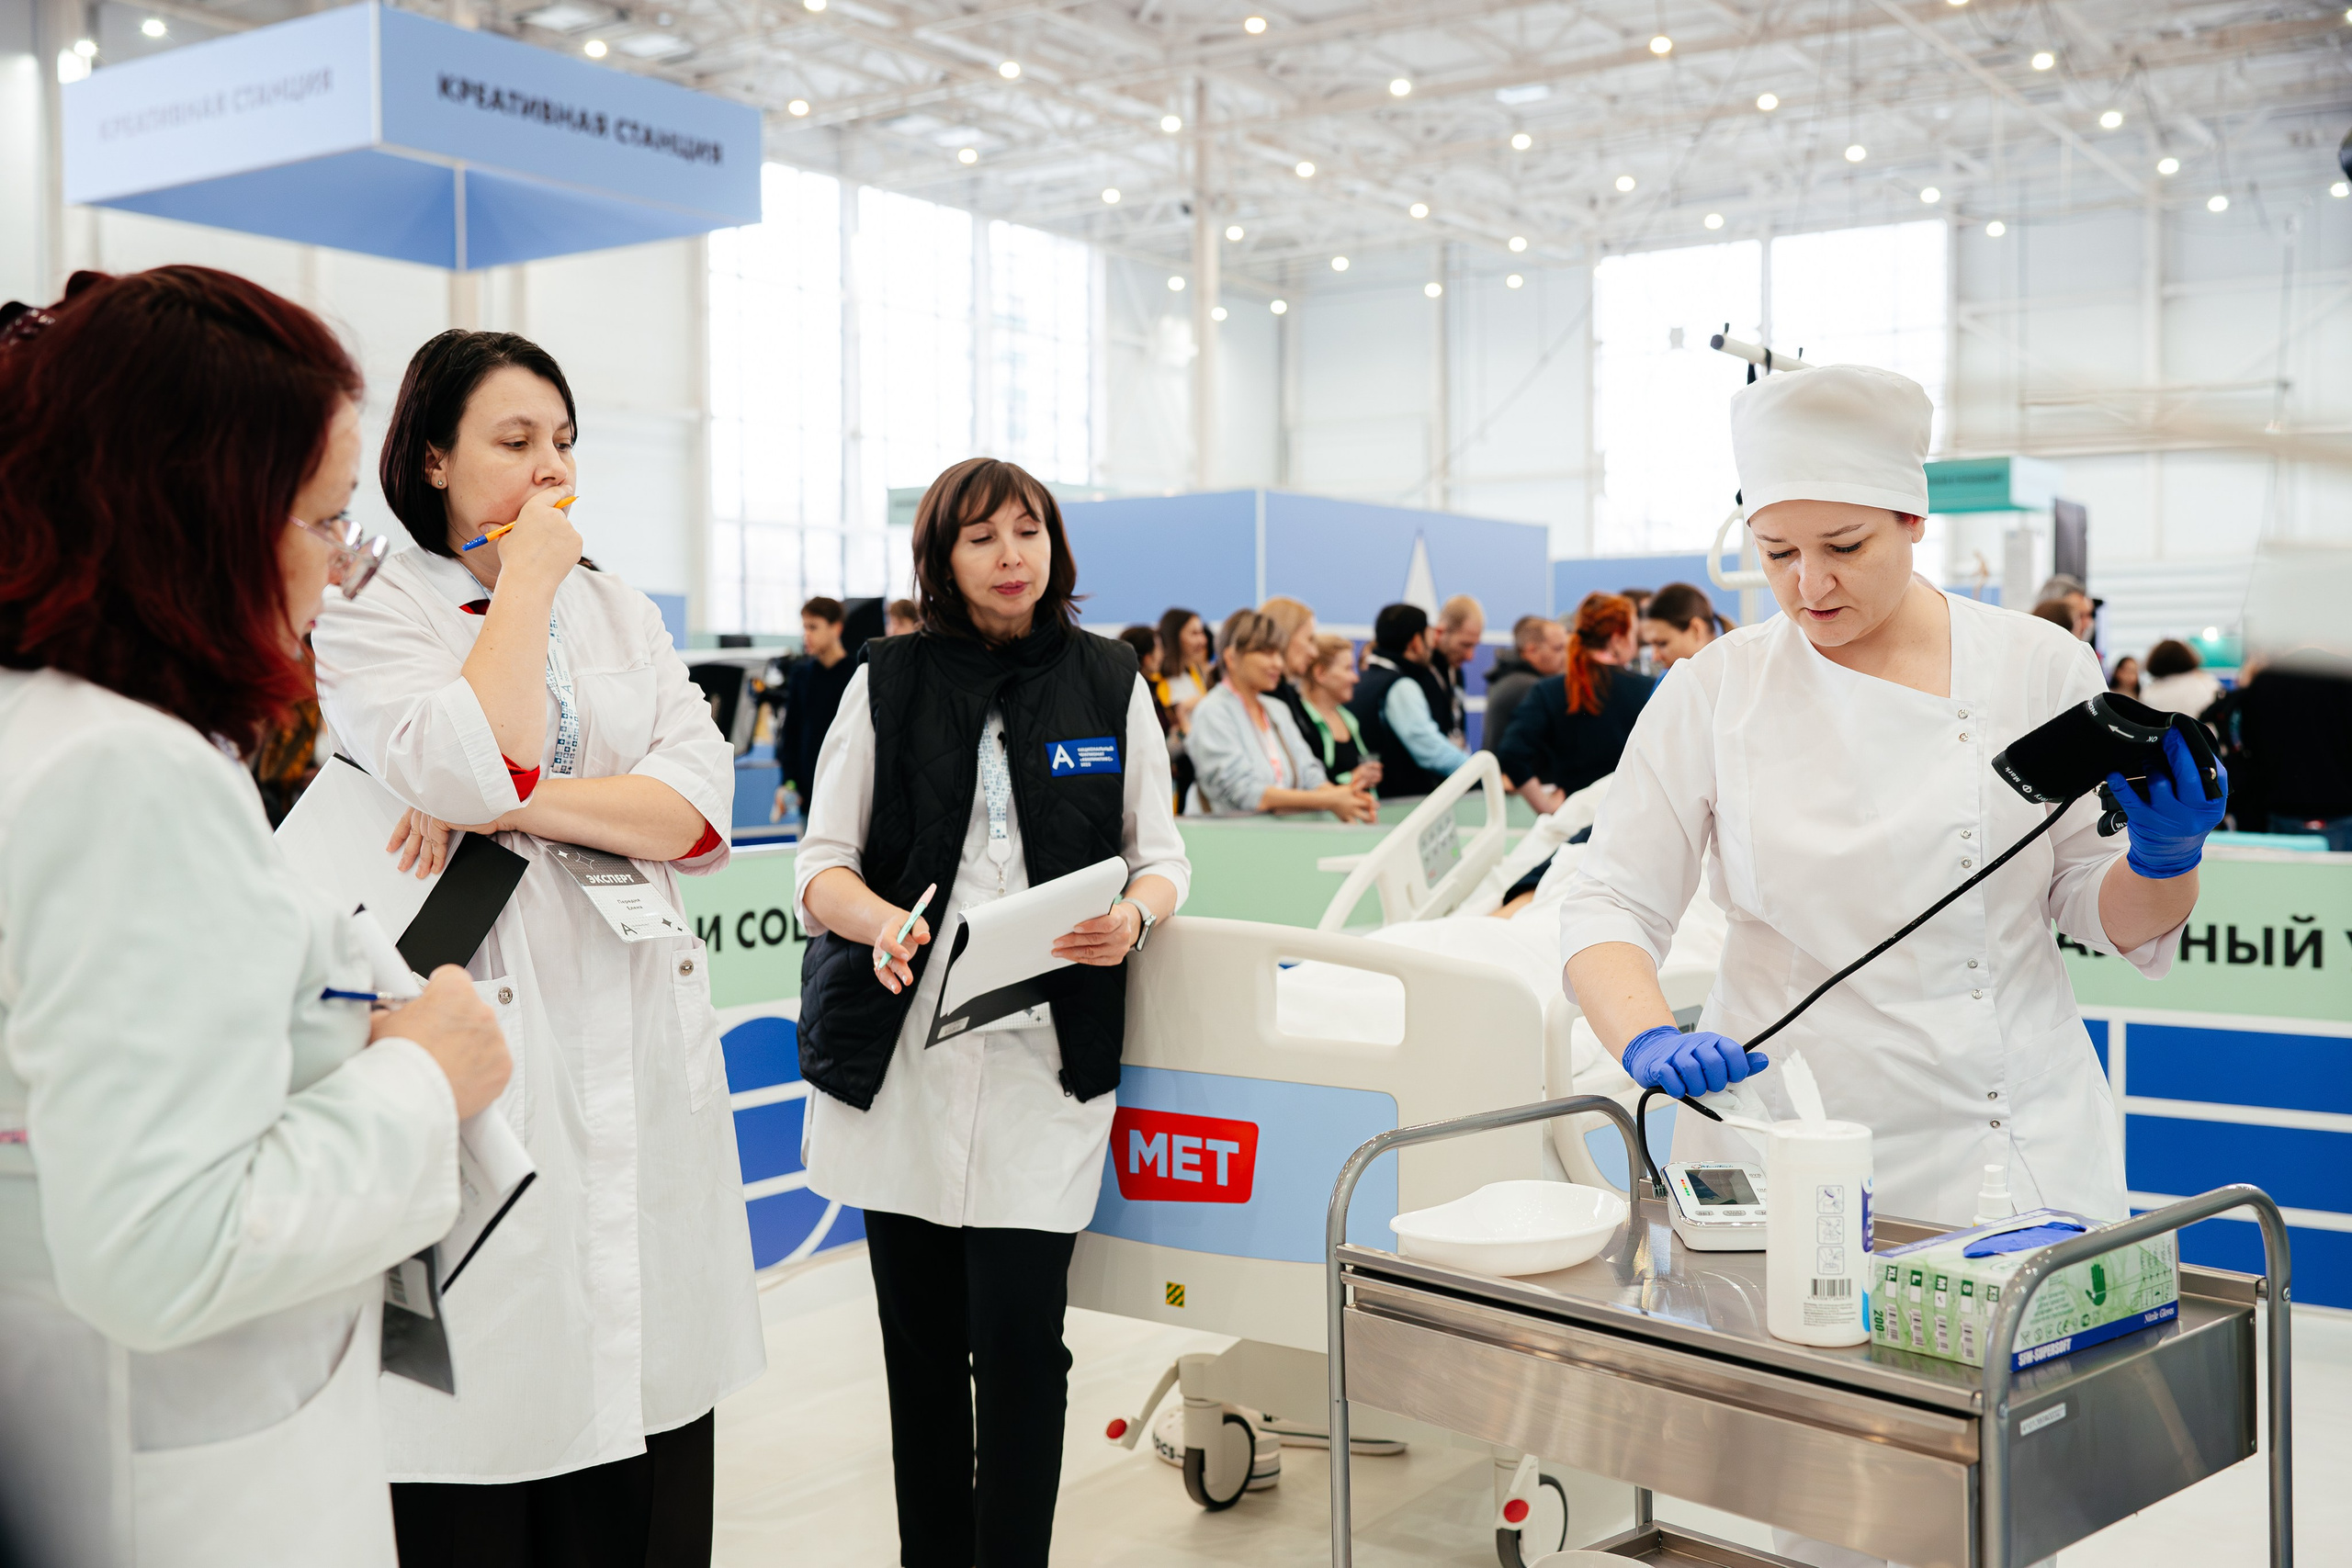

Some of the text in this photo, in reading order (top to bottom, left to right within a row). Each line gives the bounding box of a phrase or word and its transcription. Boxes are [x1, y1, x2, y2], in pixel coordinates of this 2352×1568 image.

[436, 71, 724, 166] КРЕАТИВНАЯ СТАНЦИЯ
[2005, 766, 2021, 783] Mark
[586, 874, 635, 884] ЭКСПЕРТ
[1129, 1130, 1239, 1187] MET
[1887, 1266, 1896, 1281] XL
[1937, 1278, 1947, 1288] M
[1962, 1284, 1972, 1293] S
[1988, 1287, 1998, 1302] XS
[2159, 1307, 2175, 1318] Gloves
[1873, 1309, 1884, 1332] 200
[2018, 1337, 2073, 1367] SFM-SUPERSOFT
